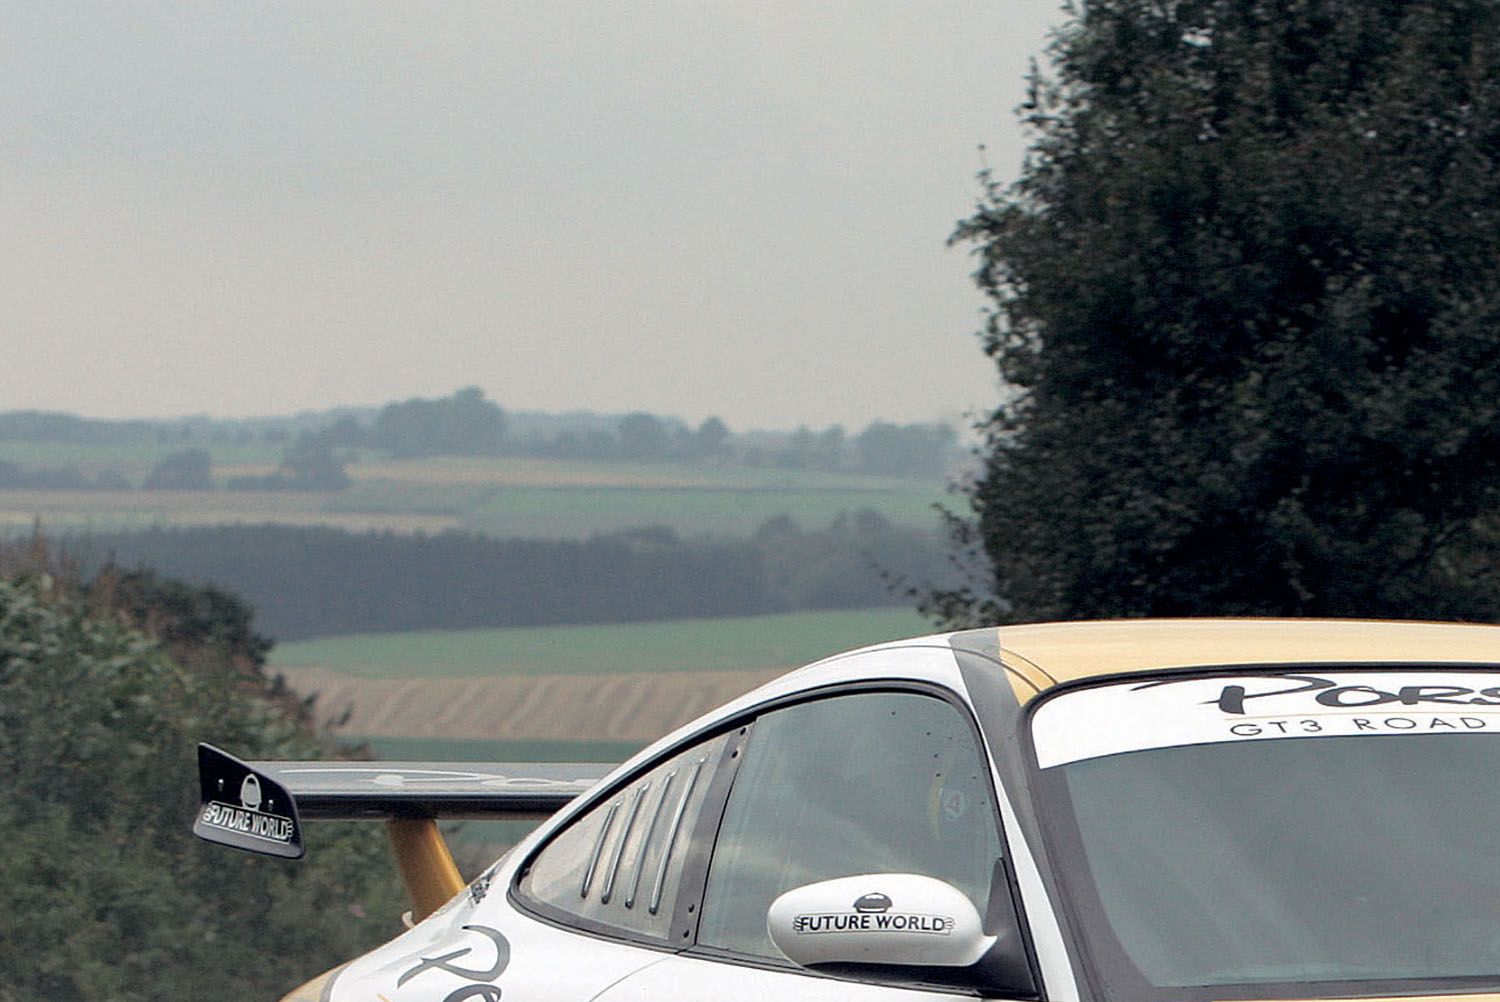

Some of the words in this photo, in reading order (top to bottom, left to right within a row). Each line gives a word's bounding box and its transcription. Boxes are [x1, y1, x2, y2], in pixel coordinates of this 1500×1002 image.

[1229, 719, 1323, 736] GT3
[1353, 717, 1487, 731] ROAD
[207, 805, 251, 832] FUTURE
[251, 813, 289, 840] WORLD
[800, 915, 870, 932] FUTURE
[876, 915, 946, 932] WORLD
